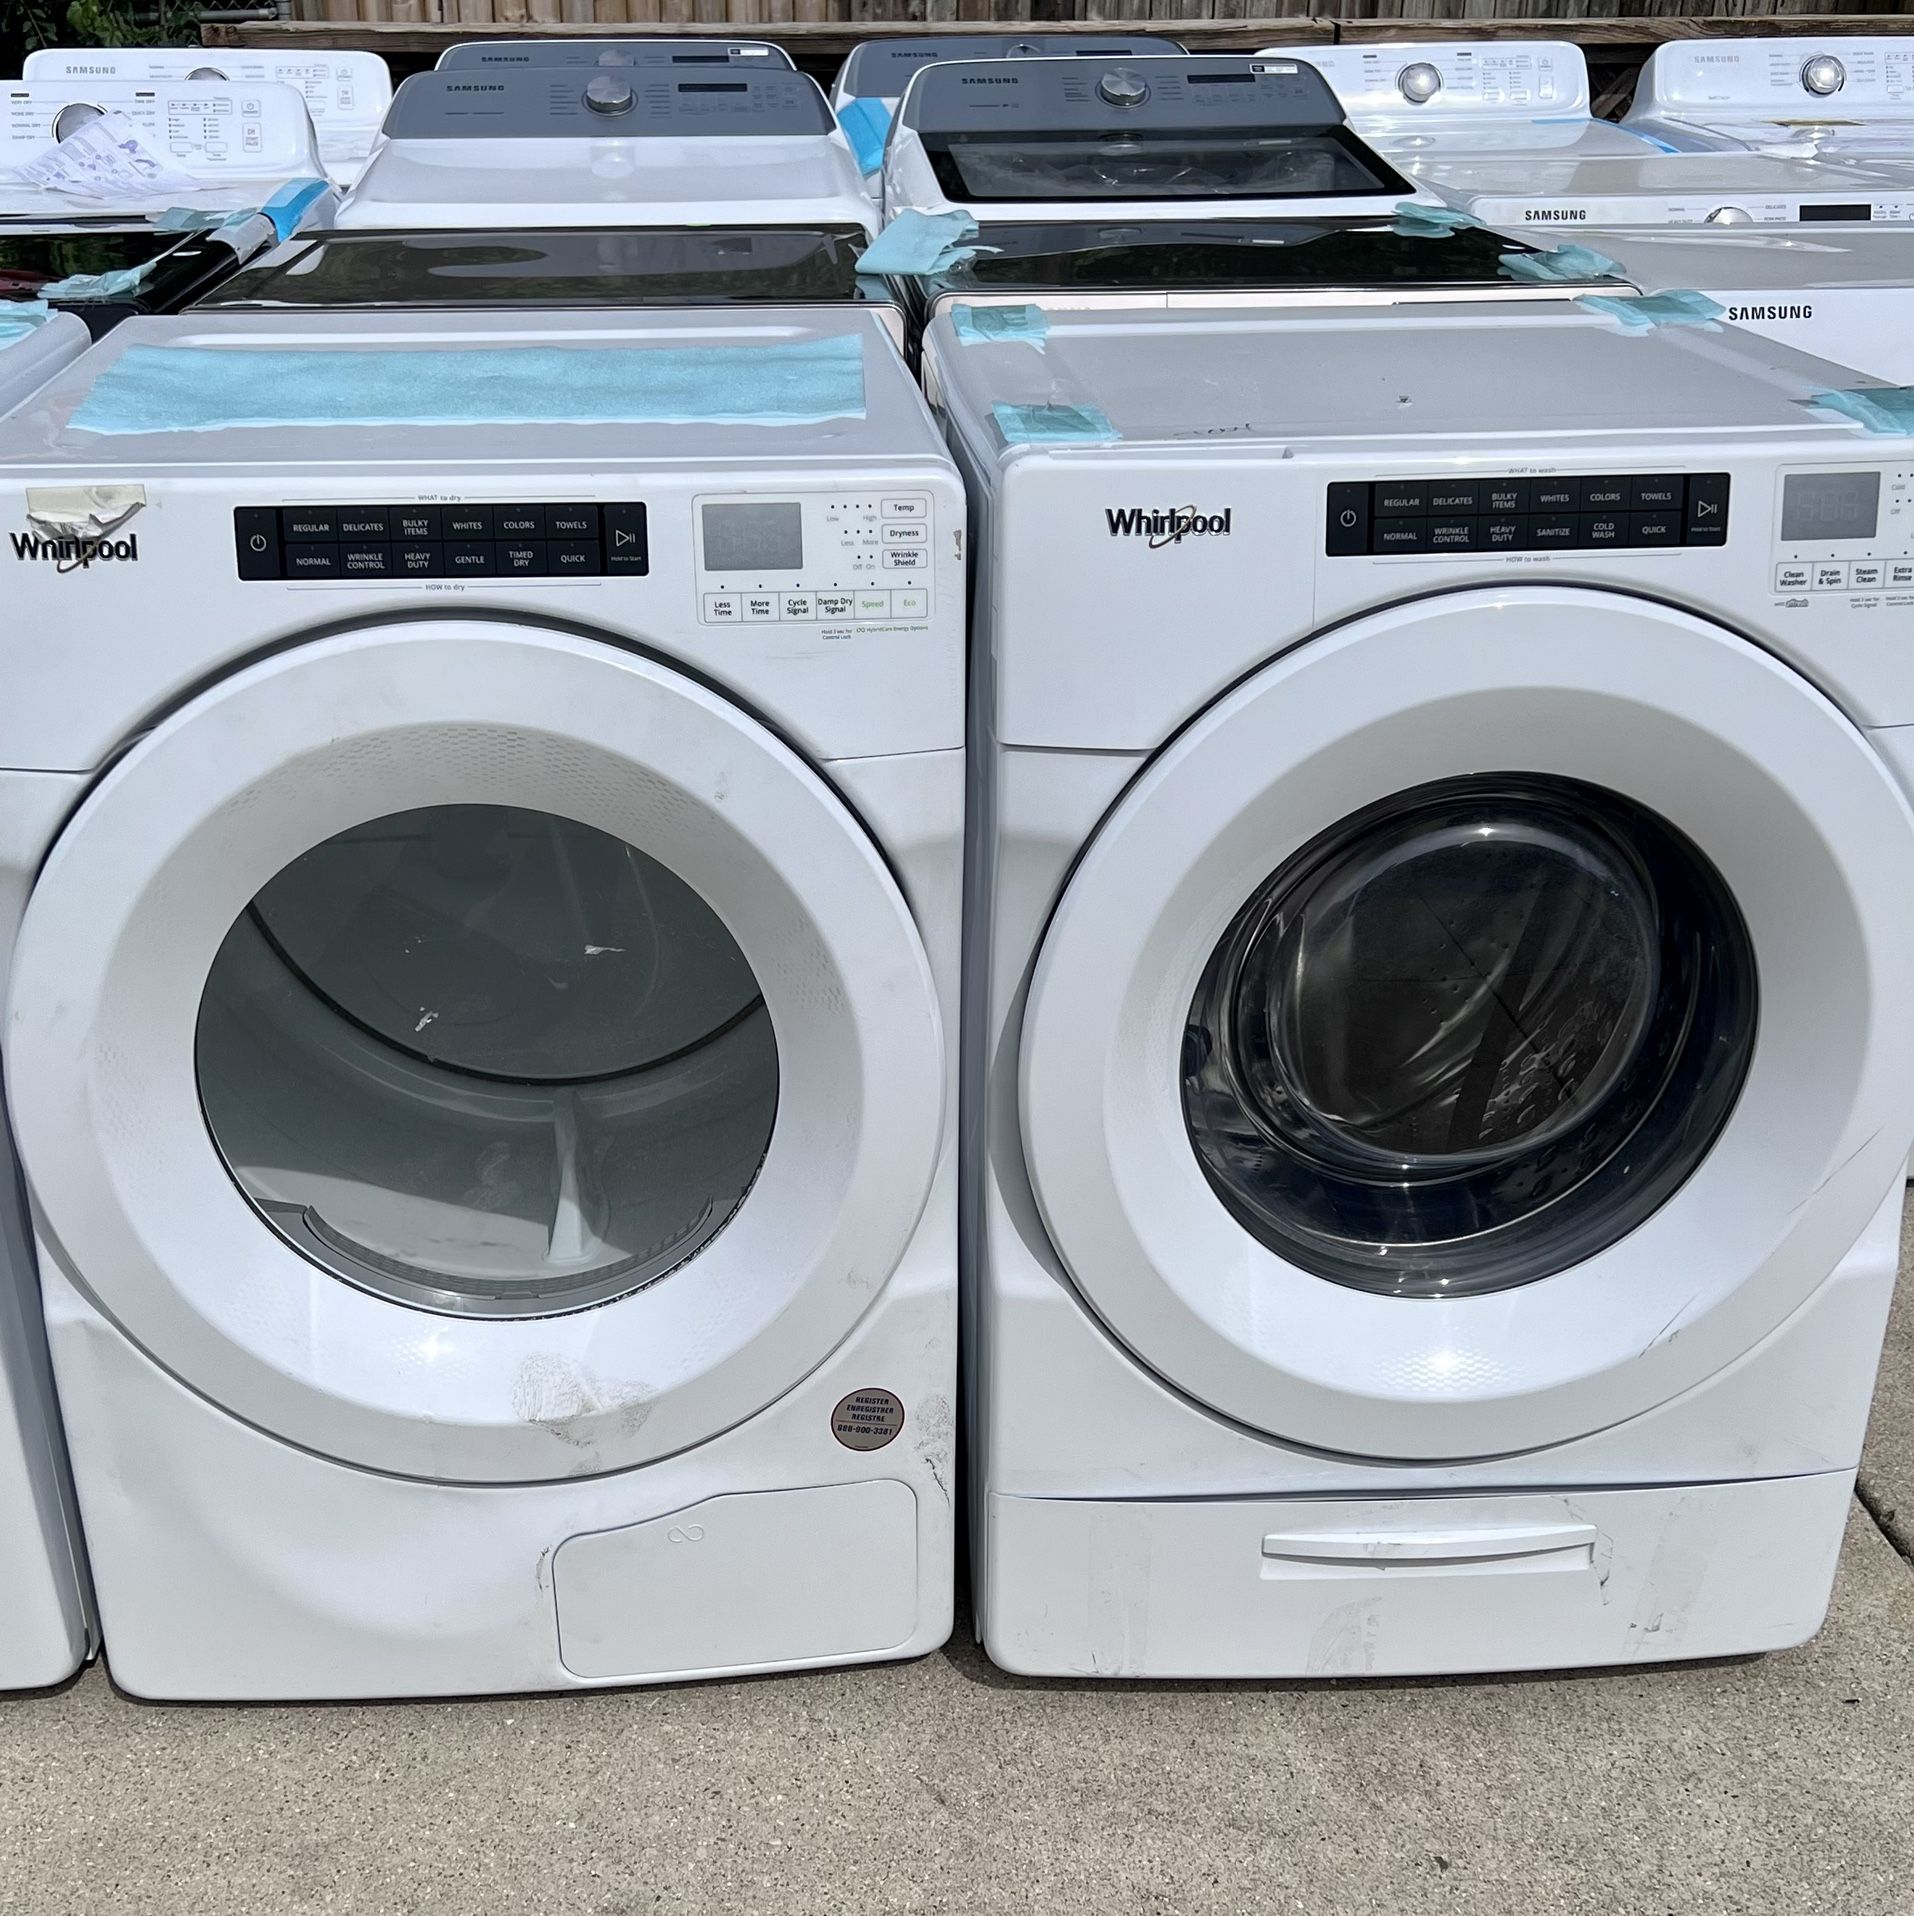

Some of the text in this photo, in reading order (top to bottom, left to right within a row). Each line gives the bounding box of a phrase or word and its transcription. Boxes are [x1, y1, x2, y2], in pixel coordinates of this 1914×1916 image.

[1694, 55, 1740, 63] SAMSUNG
[65, 65, 116, 75] SAMSUNG
[961, 77, 1019, 85] SAMSUNG
[1524, 209, 1586, 222] SAMSUNG
[1727, 305, 1813, 321] SAMSUNG
[1492, 493, 1518, 501] BULKY
[1540, 494, 1570, 503] WHITES
[1590, 493, 1621, 501] COLORS
[1641, 492, 1672, 500] TOWELS
[1384, 498, 1420, 507] REGULAR
[1433, 497, 1473, 506] DELICATES
[1492, 501, 1516, 509] ITEMS
[893, 504, 915, 513] Temp
[343, 523, 384, 532] DELICATES
[402, 519, 429, 528] BULKY
[452, 521, 483, 530] WHITES
[503, 521, 536, 530] COLORS
[556, 521, 588, 530] TOWELS
[1105, 505, 1231, 548] Whirlpool
[293, 524, 330, 533] REGULAR
[404, 528, 428, 537] ITEMS
[1434, 527, 1469, 535] WRINKLE
[1490, 526, 1516, 534] HEAVY
[1536, 528, 1570, 537] SANITIZE
[1641, 526, 1666, 534] QUICK
[889, 528, 920, 539] Dryness
[1492, 534, 1513, 542] DUTY
[1592, 531, 1615, 539] WASH
[862, 538, 879, 546] More
[1433, 535, 1470, 543] CONTROL
[347, 553, 383, 561] WRINKLE
[404, 552, 431, 561] HEAVY
[509, 550, 533, 559] TIMED
[560, 554, 586, 563] QUICK
[890, 551, 919, 560] Wrinkle
[296, 557, 331, 567] NORMAL
[347, 560, 385, 569] CONTROL
[407, 560, 429, 569] DUTY
[455, 556, 485, 565] GENTLE
[513, 558, 530, 567] DRY
[893, 559, 916, 567] Shield
[1825, 577, 1841, 585] Spin
[750, 600, 770, 608] More
[787, 599, 807, 609] Cycle
[817, 597, 853, 608] Damp Dry
[751, 607, 769, 615] Time
[787, 607, 809, 616] Signal
[825, 606, 846, 614] Signal
[856, 1397, 889, 1405] REGISTER
[846, 1405, 894, 1414] ENREGISTRER
[852, 1414, 885, 1422] REGISTRE
